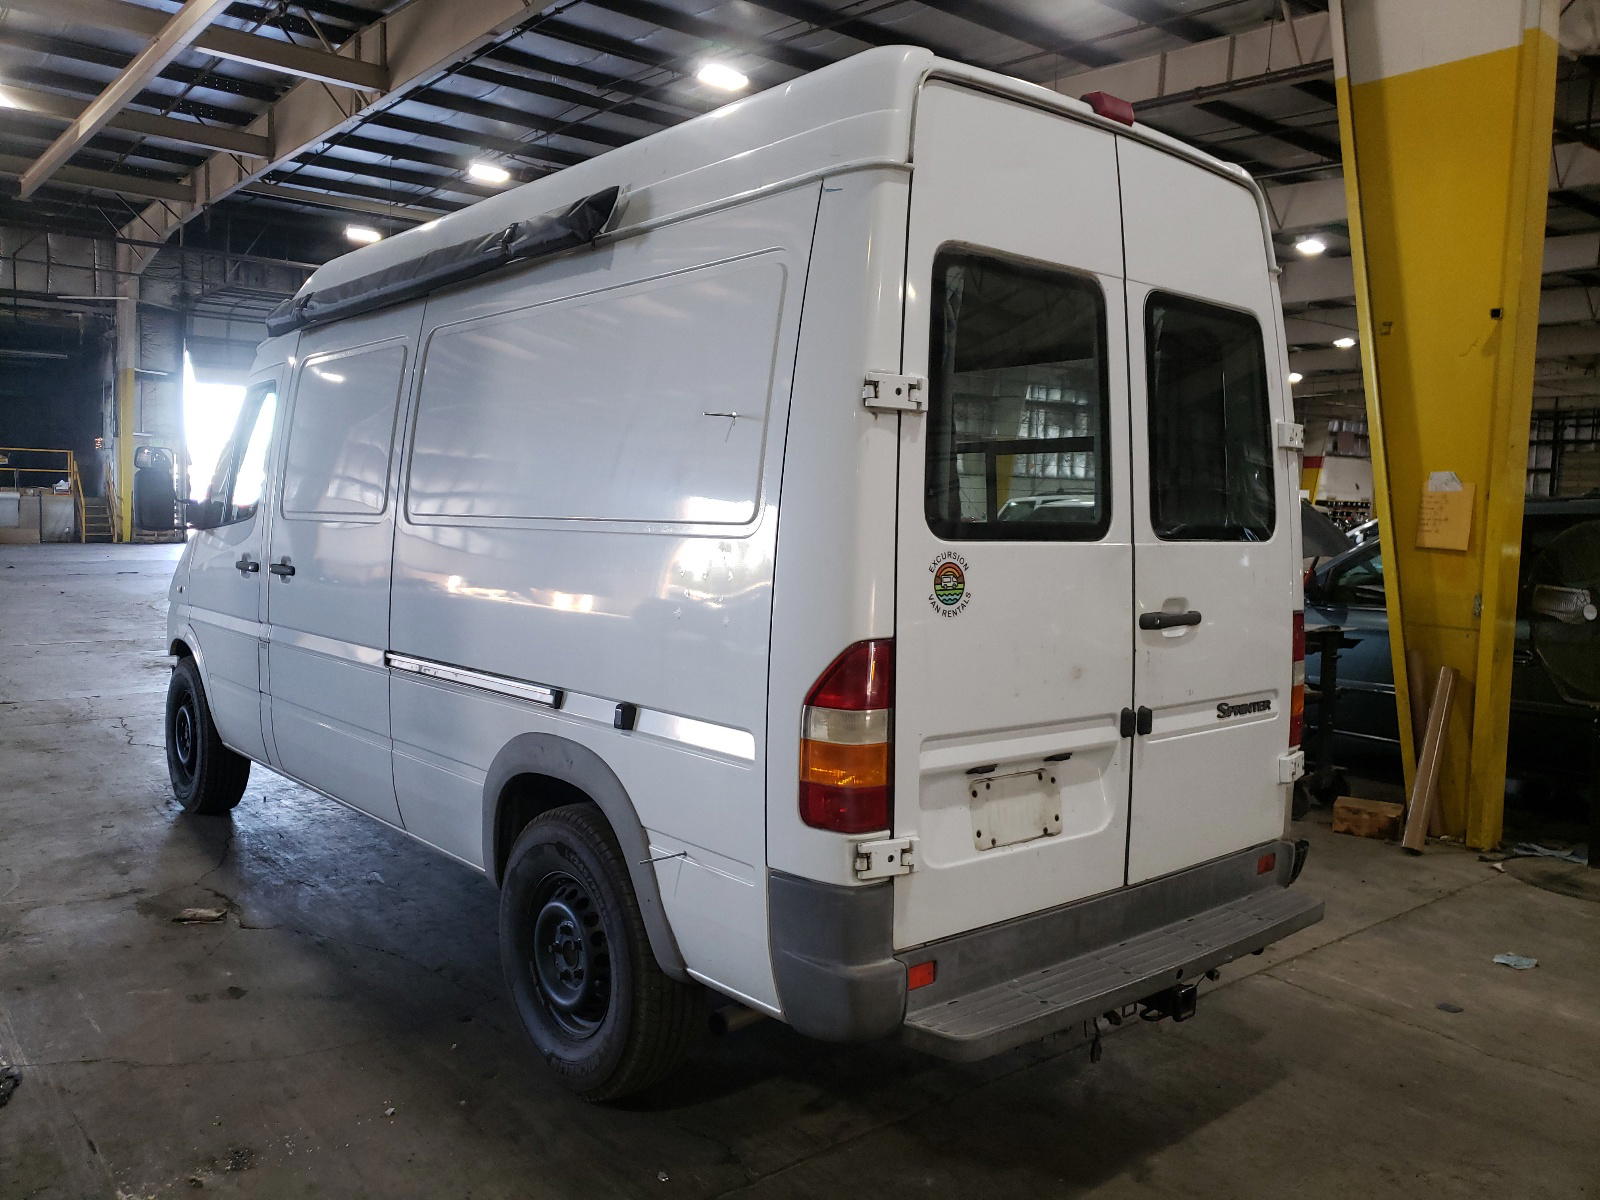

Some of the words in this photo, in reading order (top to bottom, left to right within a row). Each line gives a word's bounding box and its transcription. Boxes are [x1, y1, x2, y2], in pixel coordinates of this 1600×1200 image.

[928, 551, 970, 573] EXCURSION
[928, 594, 941, 613] VAN
[942, 591, 972, 617] RENTALS
[1216, 699, 1272, 718] SPRINTER
